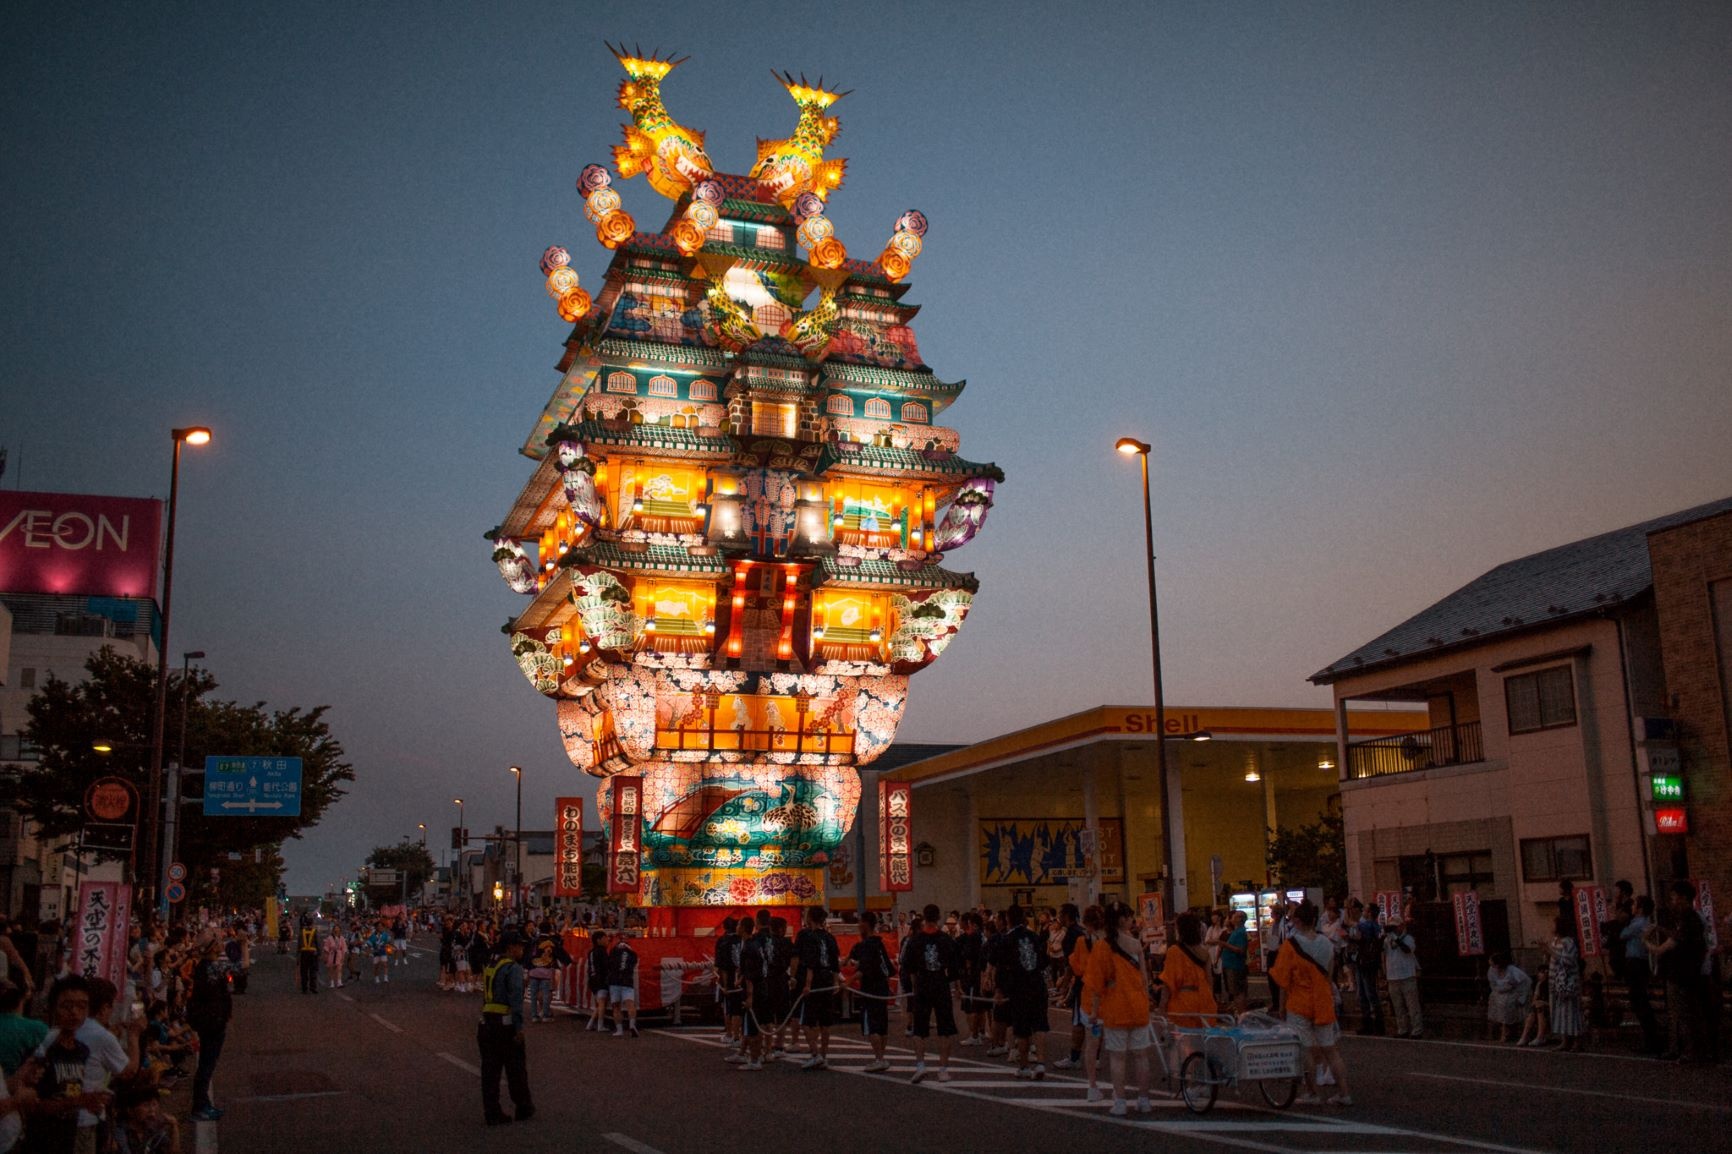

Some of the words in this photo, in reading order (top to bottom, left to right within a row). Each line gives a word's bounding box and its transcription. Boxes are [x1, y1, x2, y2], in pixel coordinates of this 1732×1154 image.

[1126, 714, 1198, 733] Shell
[262, 760, 287, 770] 秋田
[563, 806, 579, 888] わのまち能代
[891, 790, 908, 884] バスケのまち能代
